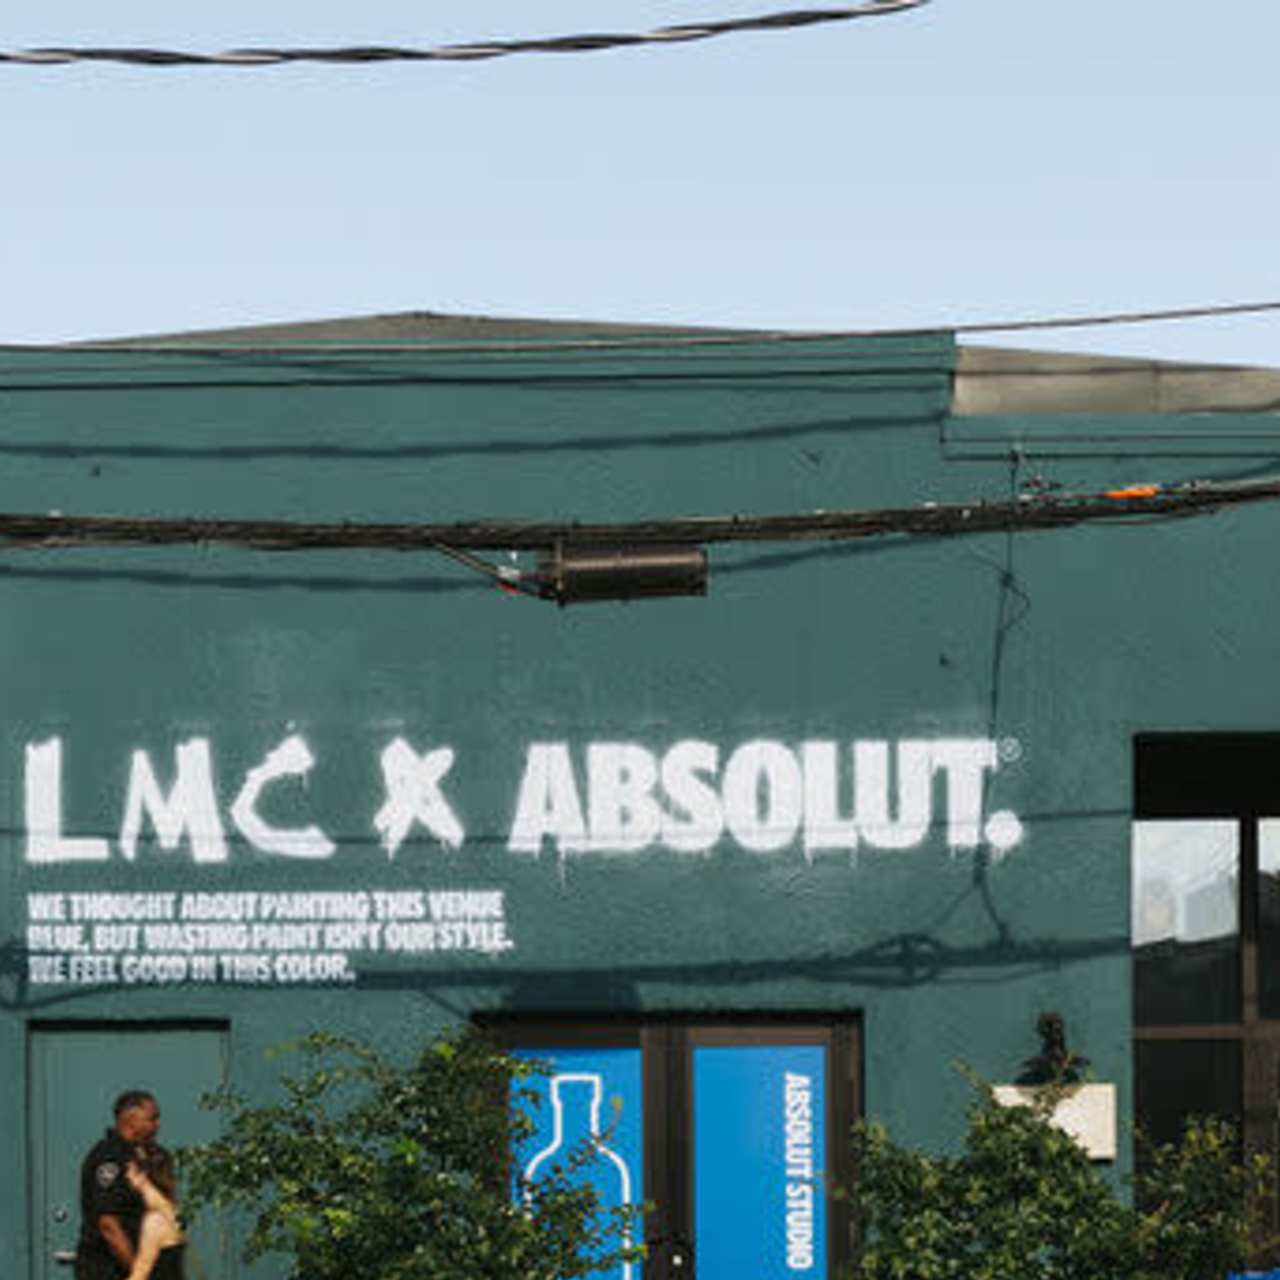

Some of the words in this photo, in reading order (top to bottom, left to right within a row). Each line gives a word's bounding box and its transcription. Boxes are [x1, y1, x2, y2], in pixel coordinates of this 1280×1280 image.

[24, 733, 337, 864] LMC
[28, 893, 66, 920] WE
[70, 893, 177, 919] THOUGHT
[181, 893, 259, 919] ABOUT
[261, 893, 370, 918] PAINTING
[374, 892, 424, 917] THIS
[428, 892, 505, 917] VENUE
[28, 925, 89, 951] BLUE,
[94, 925, 139, 949] BUT
[144, 925, 248, 949] WASTING
[251, 924, 322, 949] PAINT
[384, 923, 435, 948] OUR
[440, 923, 515, 949] STYLE.
[28, 956, 66, 983] WE
[70, 956, 121, 982] FEEL
[125, 956, 188, 981] GOOD
[191, 956, 217, 980] IN
[220, 956, 272, 980] THIS
[275, 955, 356, 980] COLOR.
[784, 1072, 812, 1182] ABSOLUT
[785, 1183, 814, 1270] STUDIO
